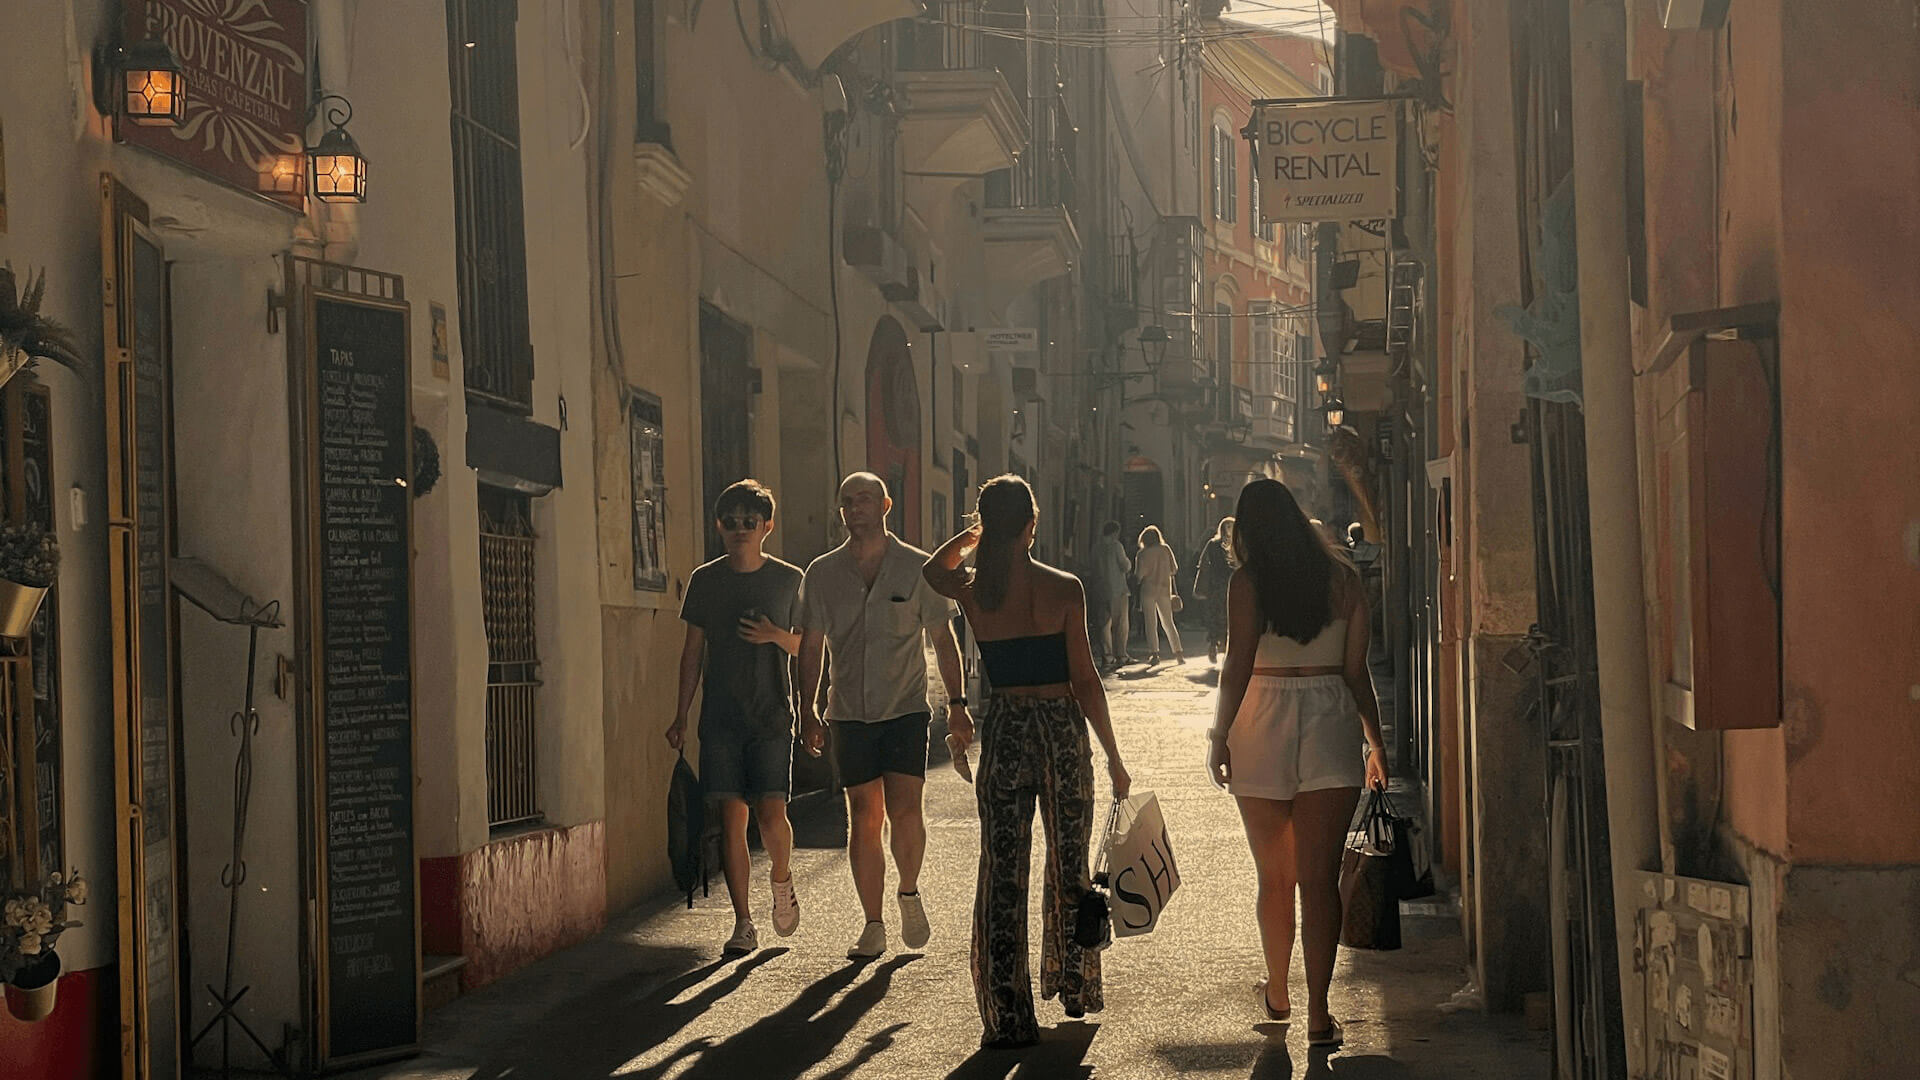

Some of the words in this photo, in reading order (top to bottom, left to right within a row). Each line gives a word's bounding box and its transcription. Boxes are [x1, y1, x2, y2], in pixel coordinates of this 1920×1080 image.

[145, 0, 291, 110] PROVENZAL
[184, 66, 218, 97] TAPAS
[1266, 115, 1387, 146] BICYCLE
[1274, 151, 1381, 180] RENTAL
[1296, 192, 1365, 207] SPECIALIZED
[329, 348, 354, 367] TAPAS
[1115, 824, 1180, 929] SH
